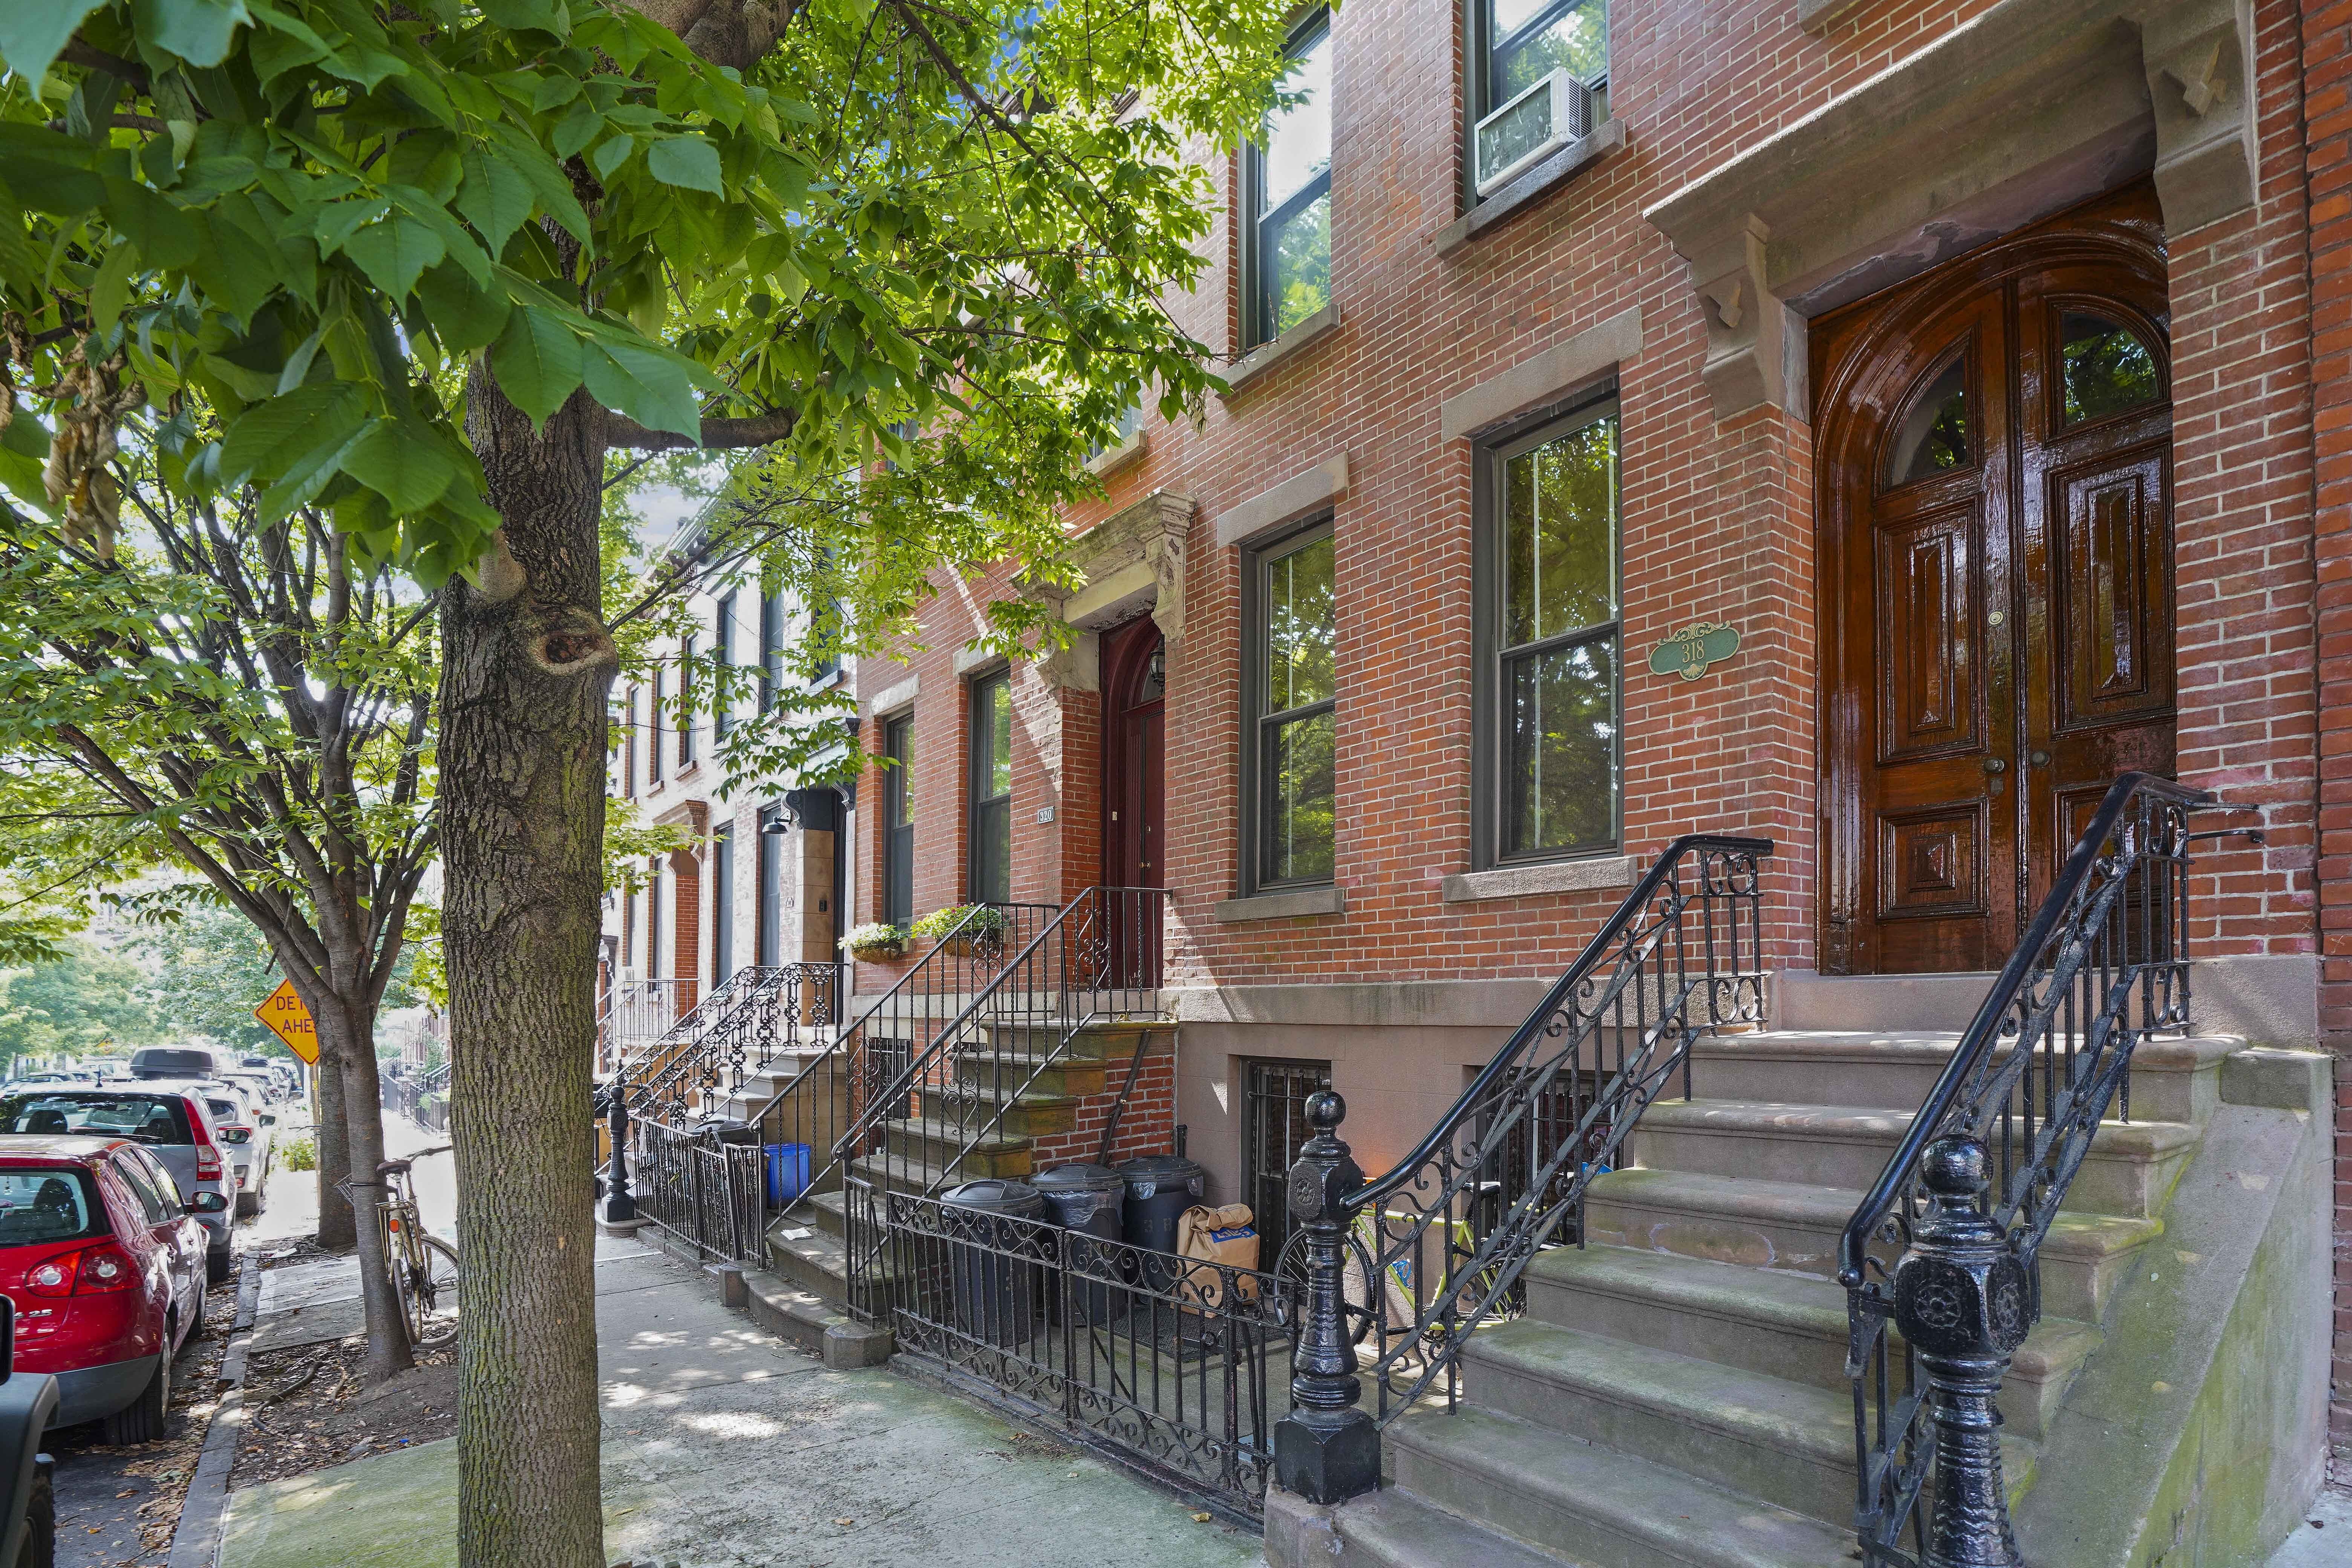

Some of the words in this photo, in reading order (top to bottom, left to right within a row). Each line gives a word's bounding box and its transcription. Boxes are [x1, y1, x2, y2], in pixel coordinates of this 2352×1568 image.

[1682, 640, 1704, 663] 318
[1040, 809, 1051, 822] 320
[282, 1018, 316, 1033] AHE
